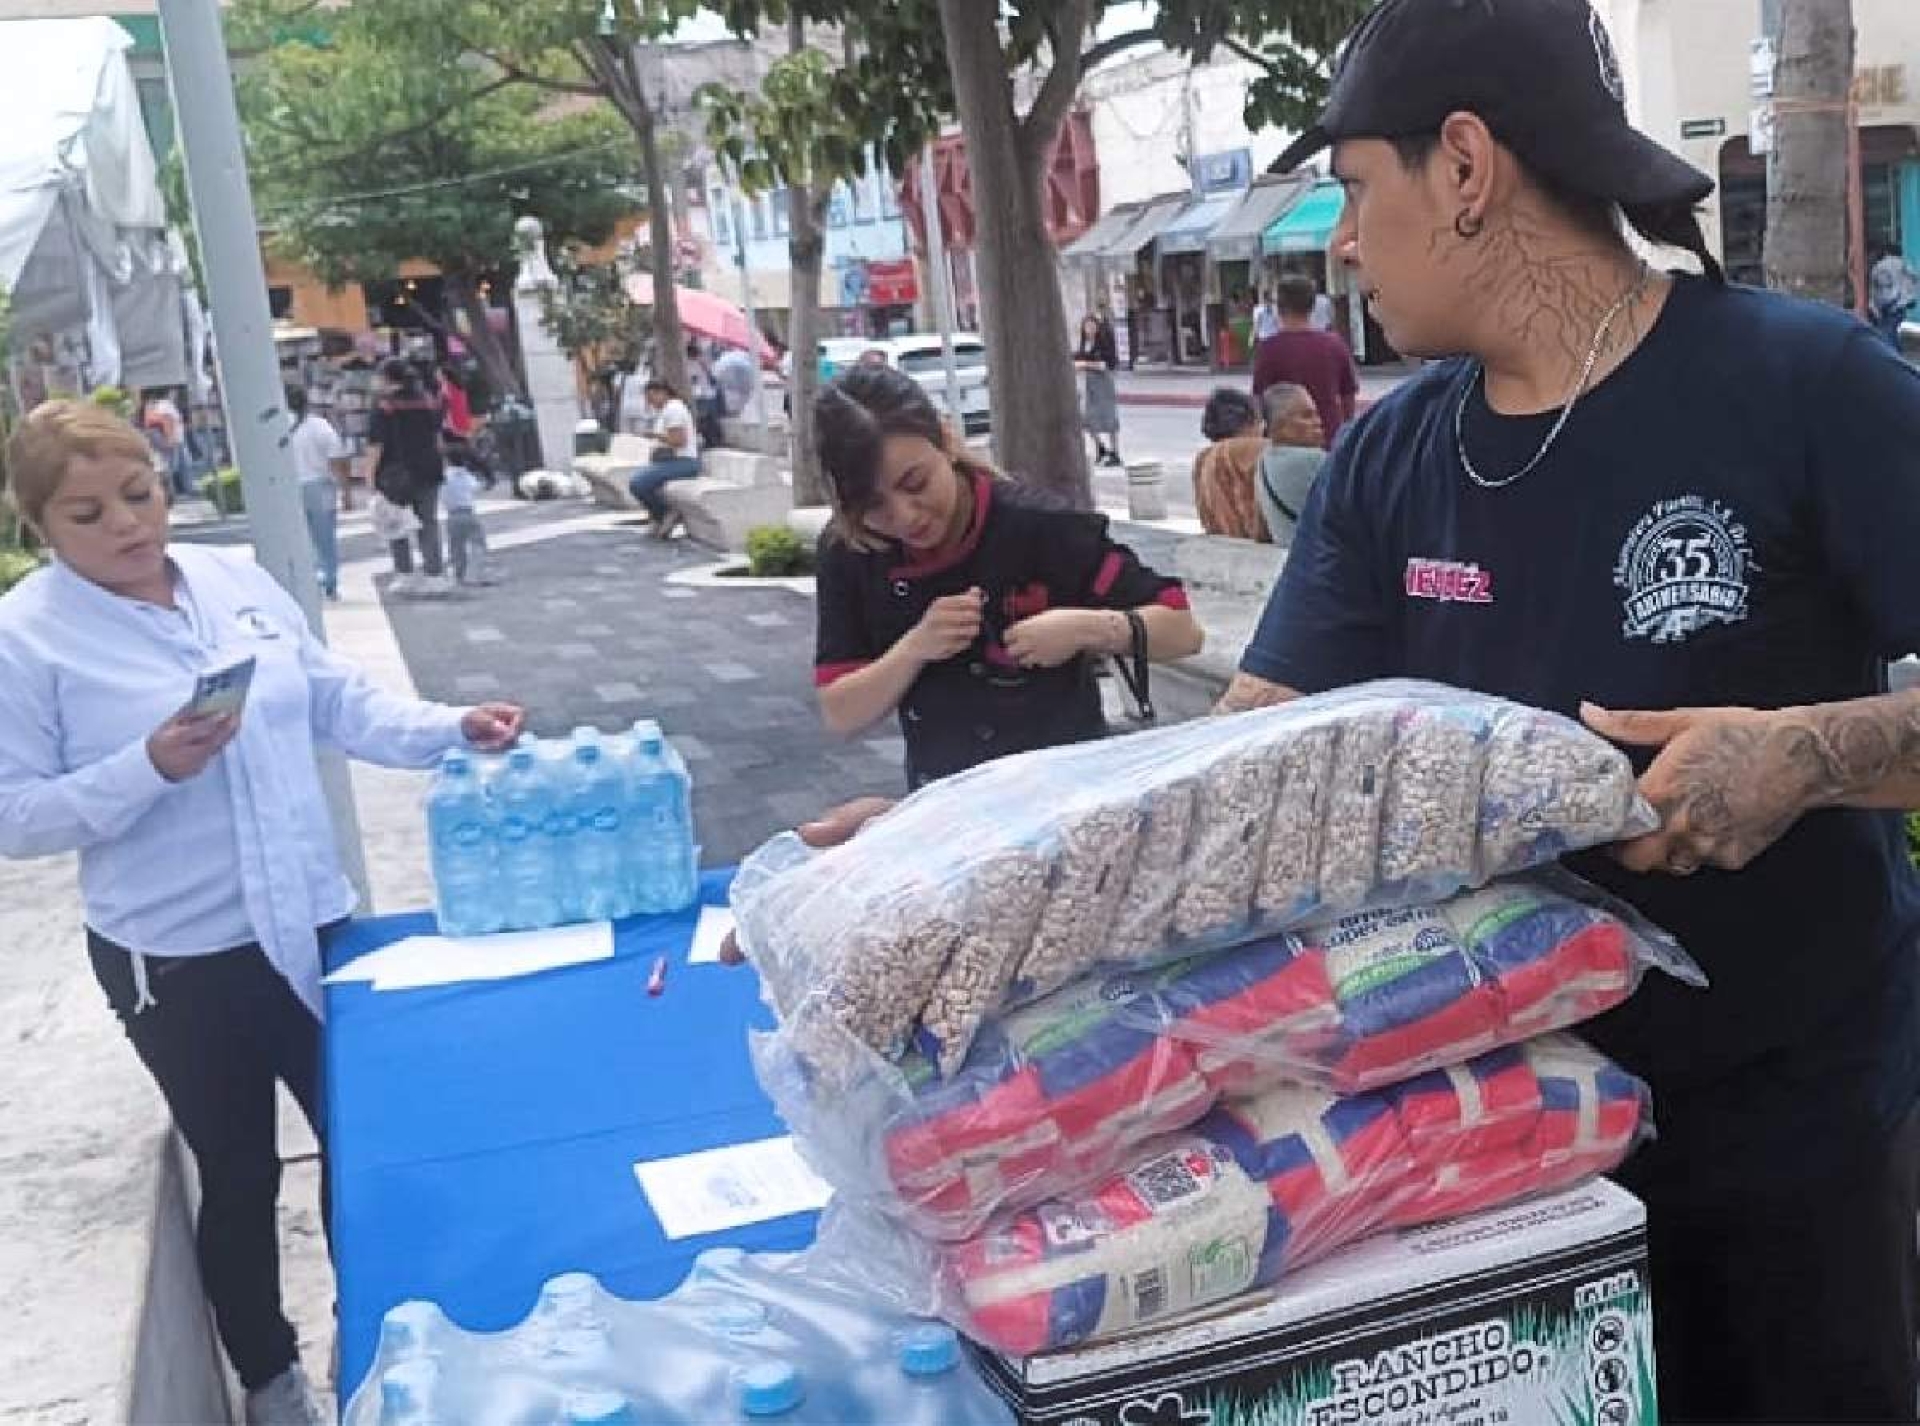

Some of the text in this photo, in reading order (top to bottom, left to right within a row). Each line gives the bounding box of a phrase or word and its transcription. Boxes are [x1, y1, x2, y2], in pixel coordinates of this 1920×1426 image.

[1658, 527, 1713, 579] 35
[1635, 582, 1738, 619] ANIVERSARIO
[1309, 1347, 1534, 1426] ESCONDIDO
[1336, 1321, 1506, 1394] RANCHO
